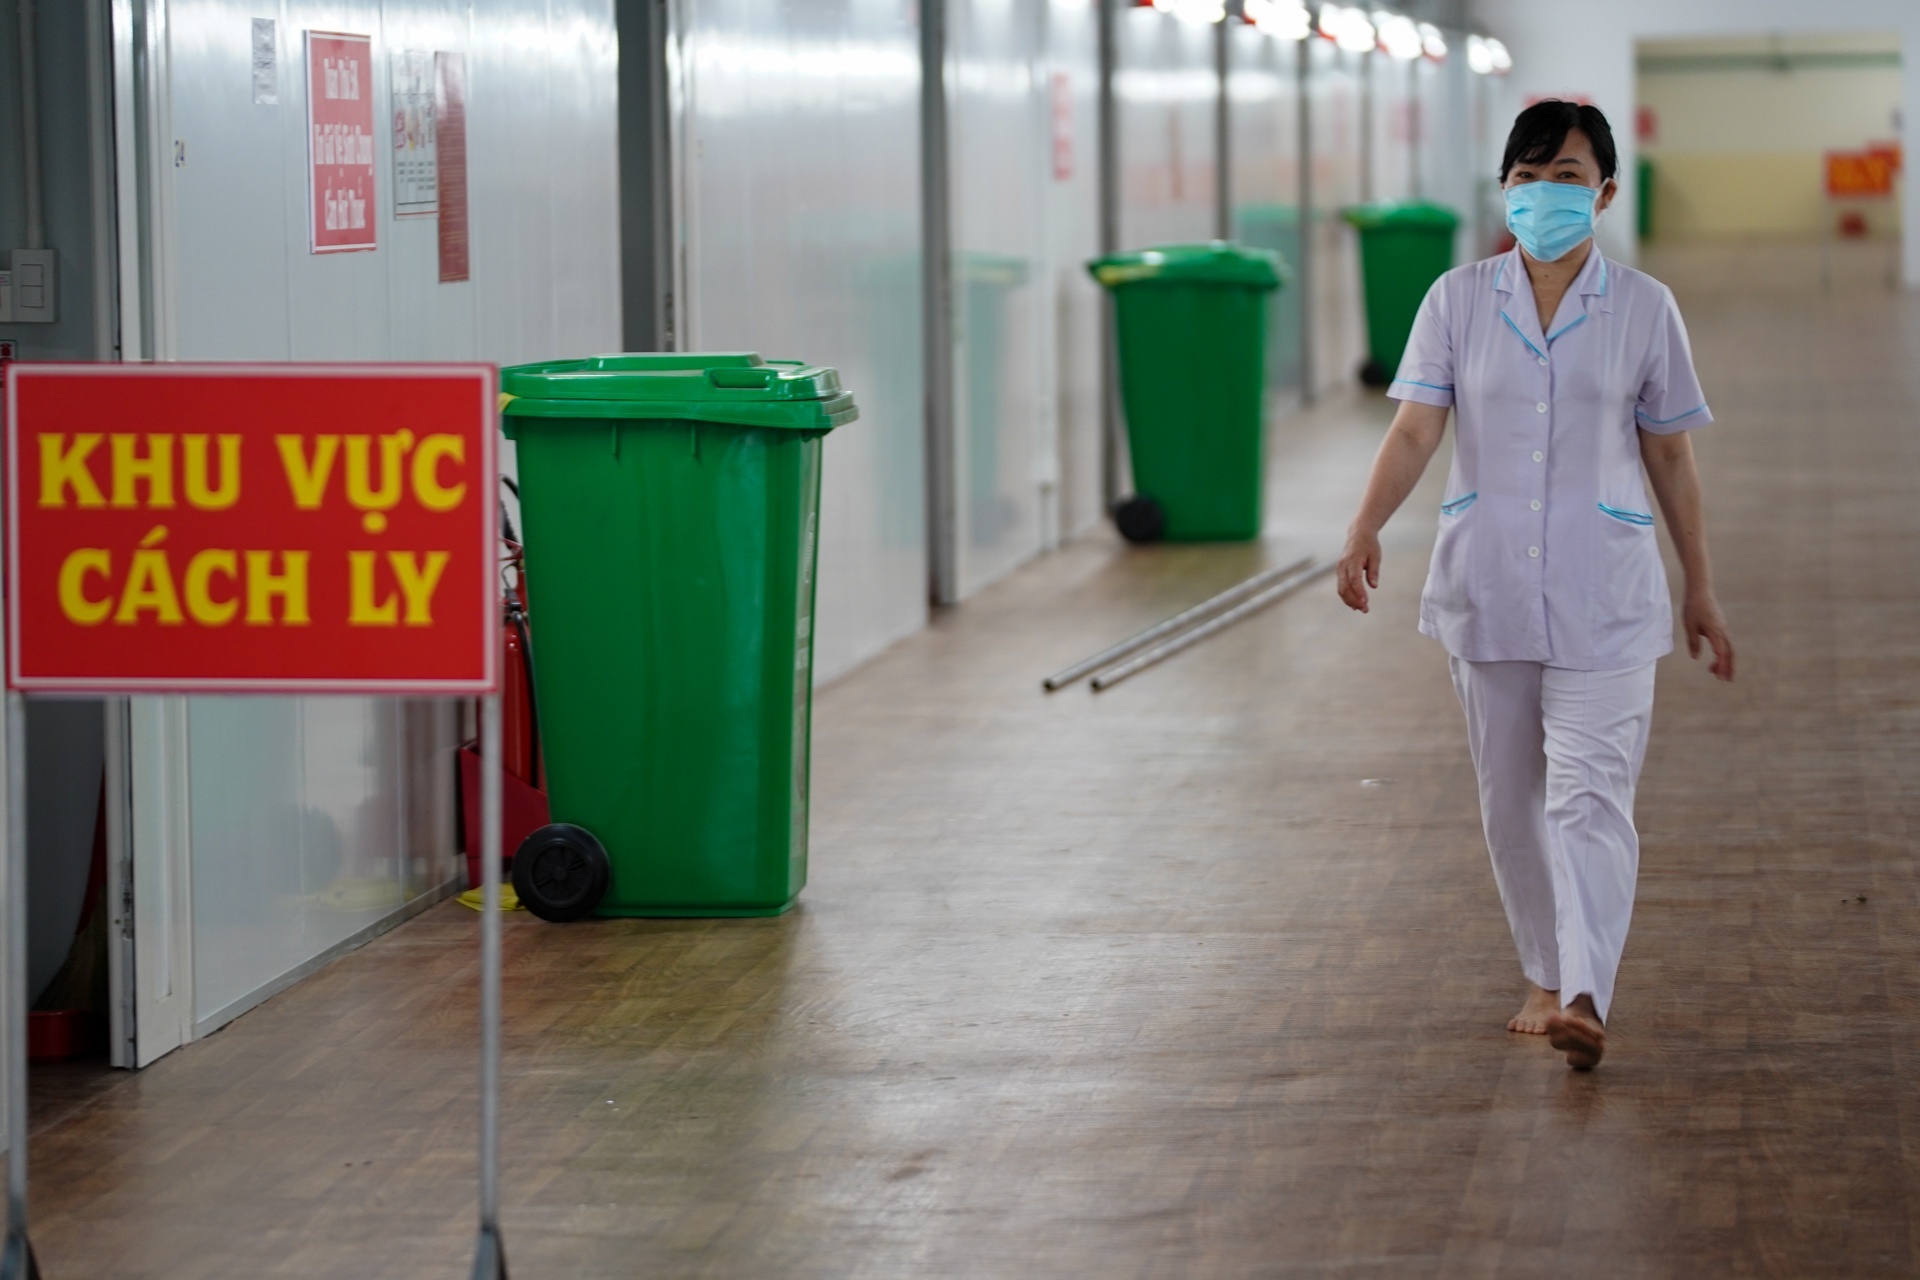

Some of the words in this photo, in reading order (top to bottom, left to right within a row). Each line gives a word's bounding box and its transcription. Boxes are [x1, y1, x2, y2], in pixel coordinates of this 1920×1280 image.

[38, 432, 242, 508] KHU
[276, 428, 466, 534] VỰC
[58, 525, 311, 627] CÁCH
[348, 551, 450, 627] LY
